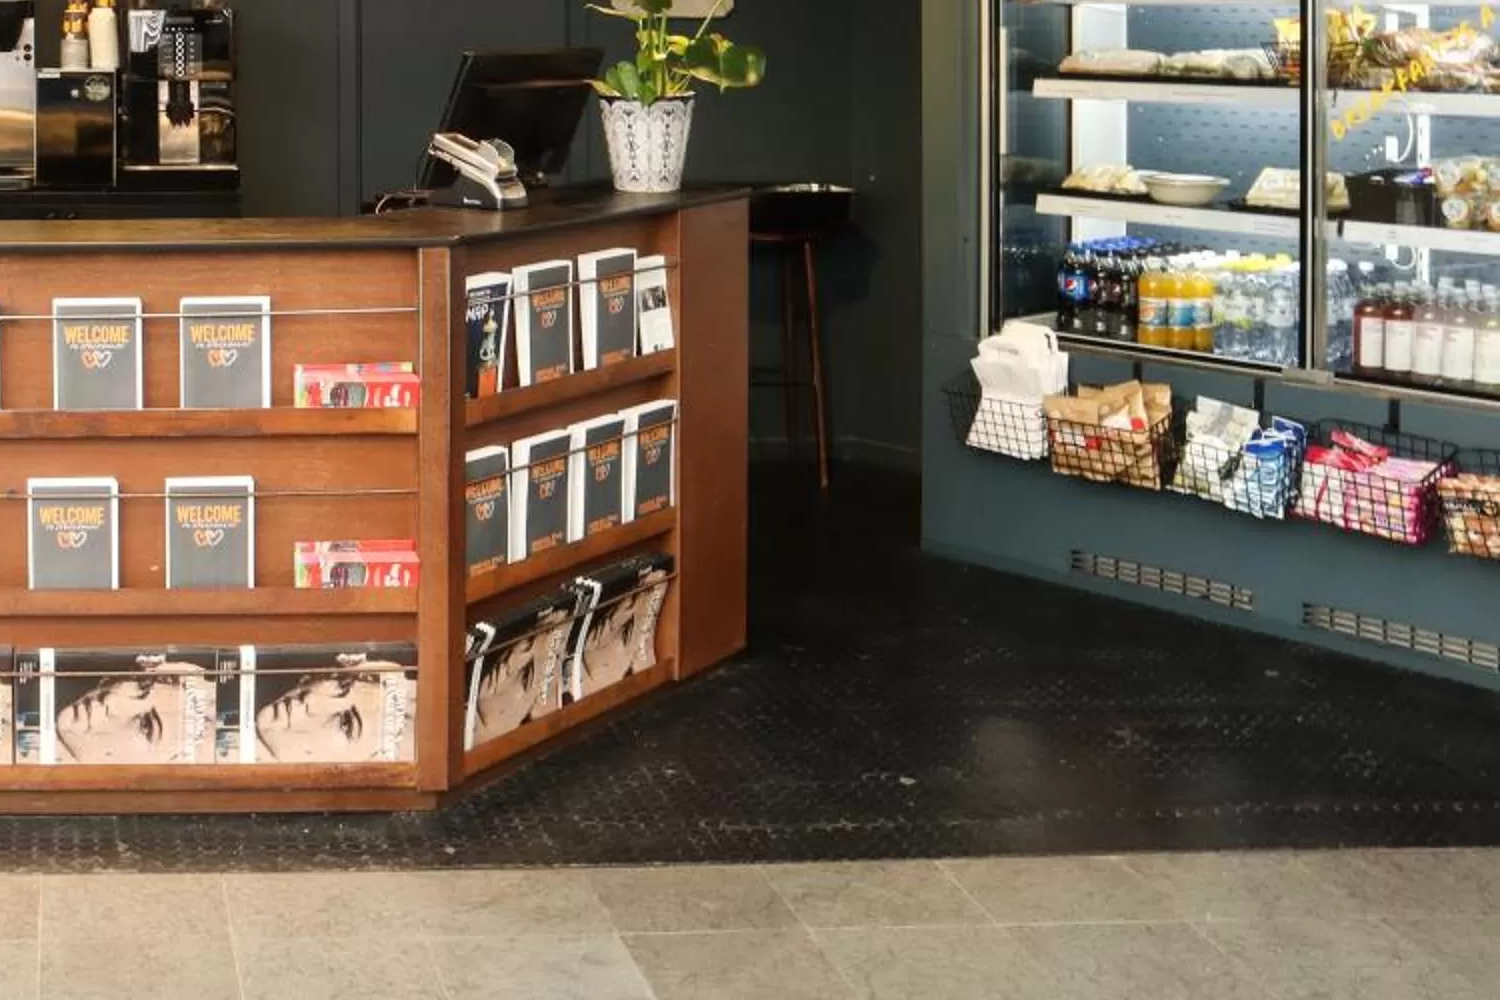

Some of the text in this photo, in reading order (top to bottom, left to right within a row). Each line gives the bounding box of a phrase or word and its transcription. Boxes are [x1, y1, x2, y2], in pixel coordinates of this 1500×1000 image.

[65, 324, 130, 344] WELCOME
[189, 323, 256, 343] WELCOME
[38, 505, 104, 525] WELCOME
[176, 505, 242, 525] WELCOME
